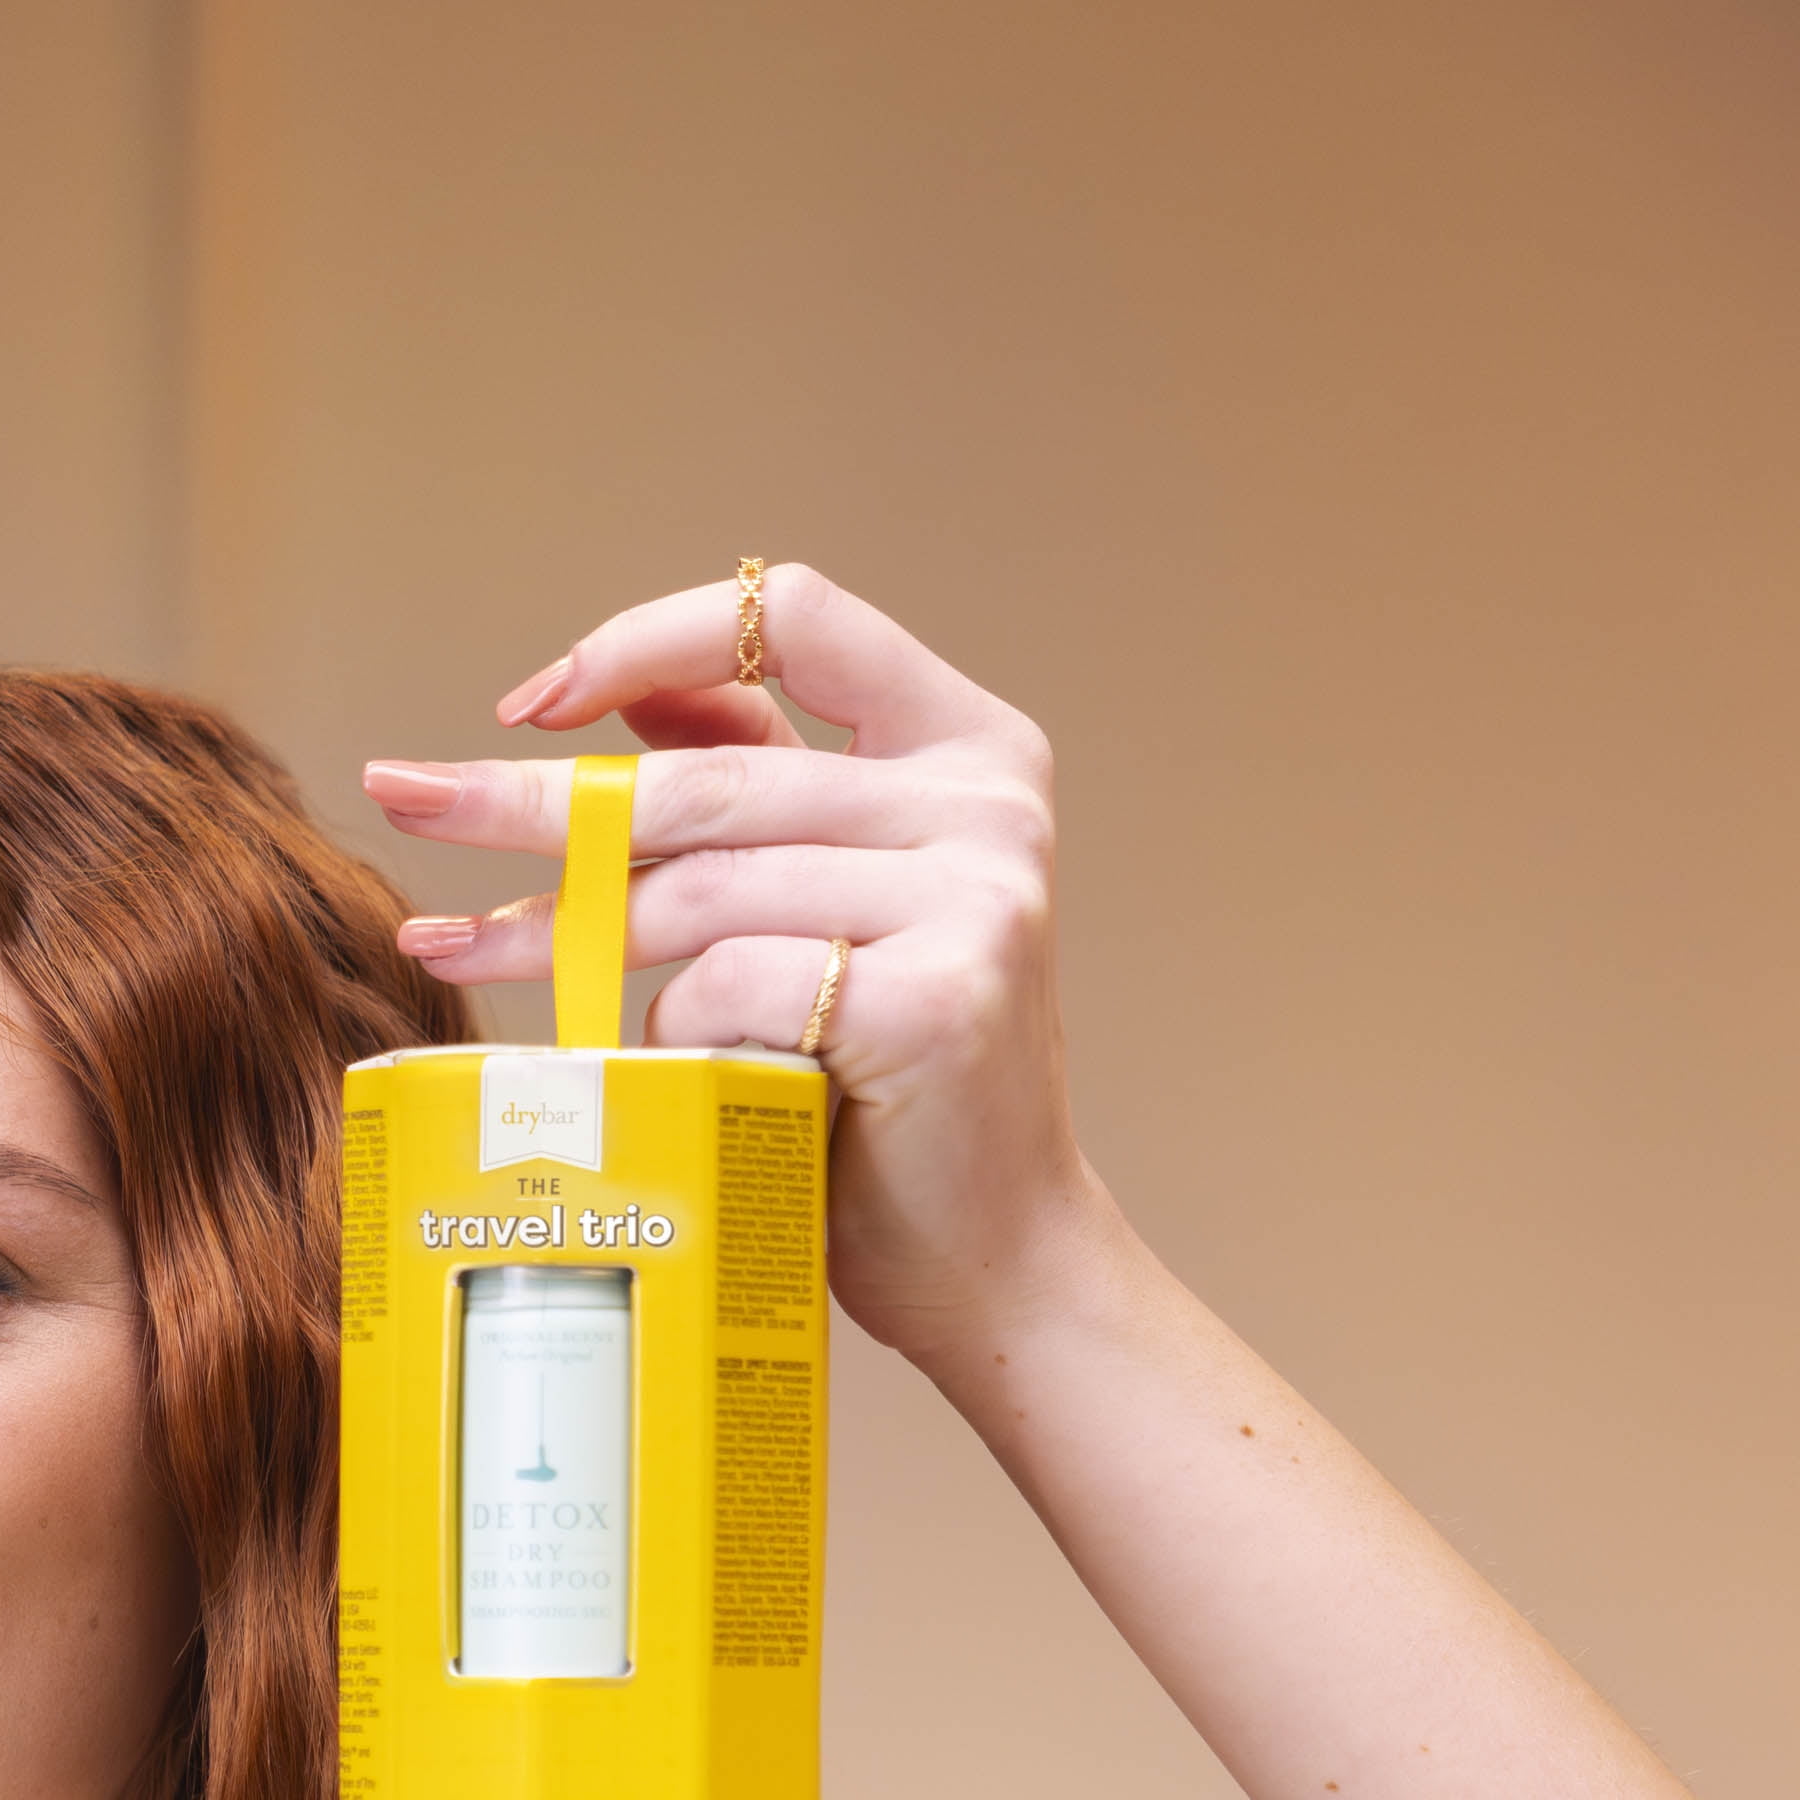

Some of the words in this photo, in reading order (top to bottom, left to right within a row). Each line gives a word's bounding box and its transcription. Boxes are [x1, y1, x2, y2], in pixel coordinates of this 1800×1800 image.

[501, 1102, 579, 1134] drybar
[517, 1178, 561, 1196] THE
[419, 1205, 564, 1248] travel
[579, 1204, 674, 1248] trio
[472, 1503, 610, 1531] DETOX
[508, 1543, 564, 1561] DRY
[469, 1568, 612, 1591] SHAMPOO
